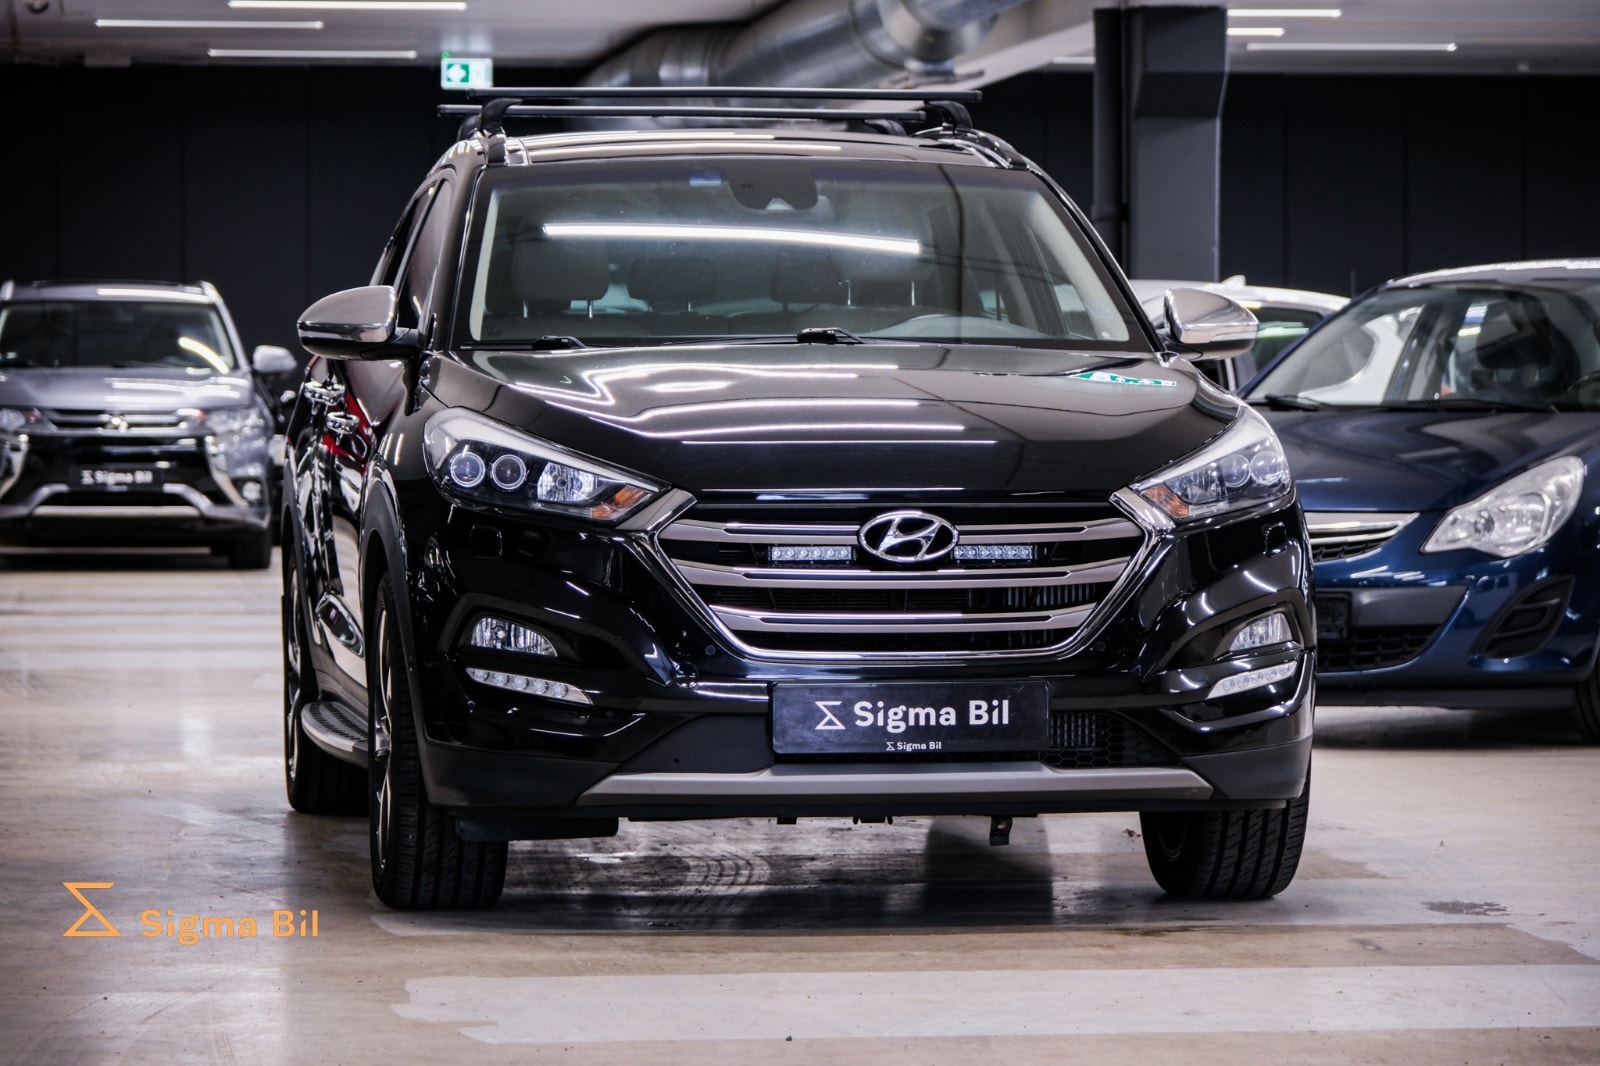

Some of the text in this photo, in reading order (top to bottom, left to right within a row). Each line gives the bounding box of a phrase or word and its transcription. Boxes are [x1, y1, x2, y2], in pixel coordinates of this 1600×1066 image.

[853, 699, 1009, 734] Sigma Bil
[896, 741, 942, 752] Sigma Bil
